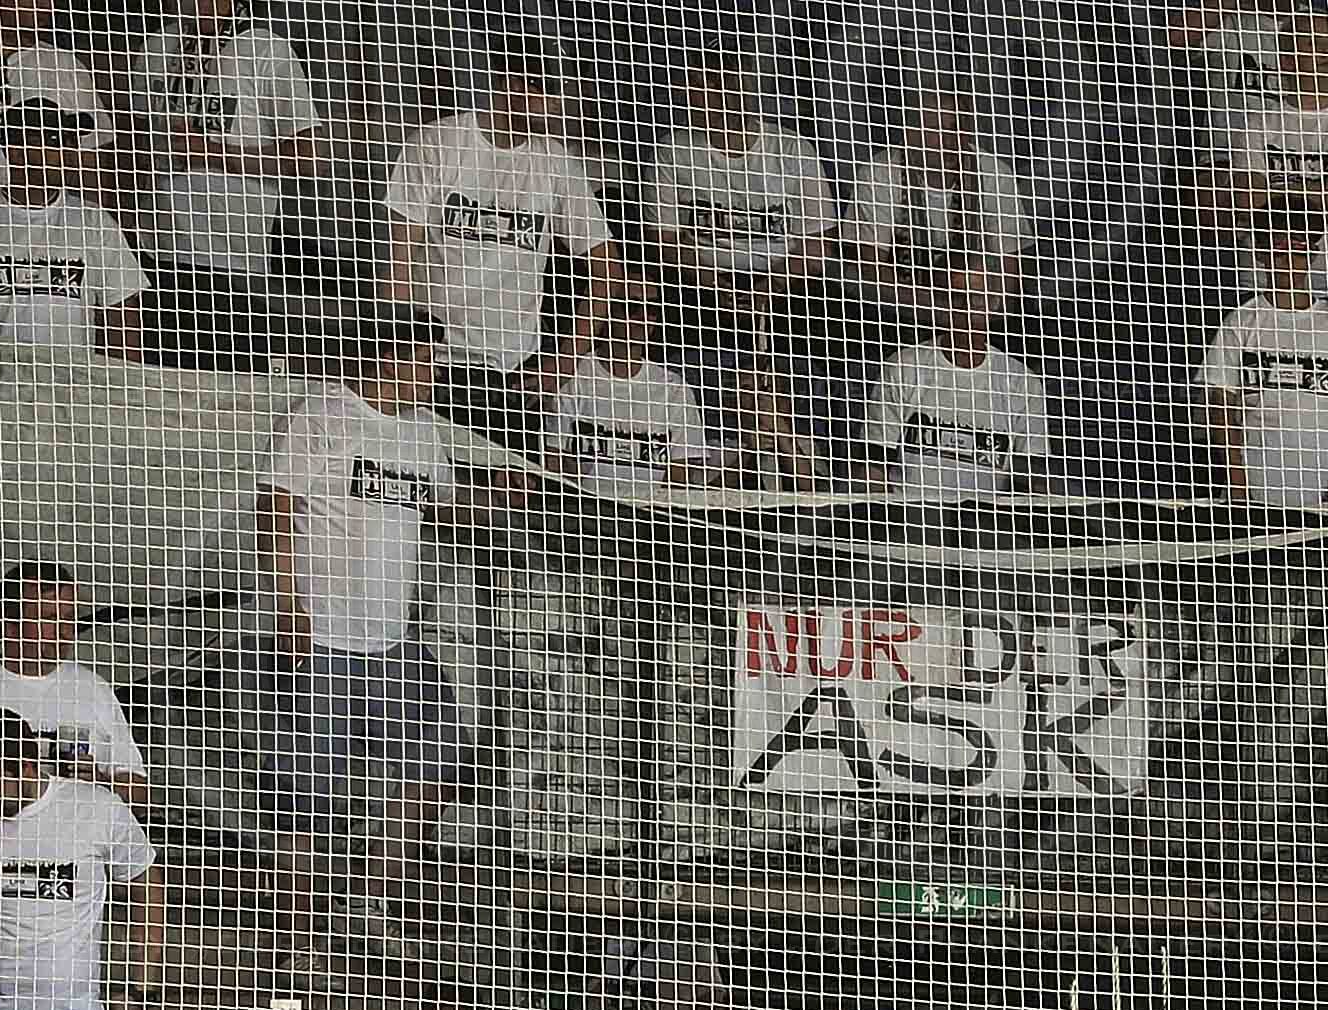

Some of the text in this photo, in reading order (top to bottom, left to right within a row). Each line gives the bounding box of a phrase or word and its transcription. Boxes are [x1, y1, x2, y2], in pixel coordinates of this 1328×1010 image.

[746, 610, 1136, 689] NUR DER
[740, 684, 1135, 795] ASK
